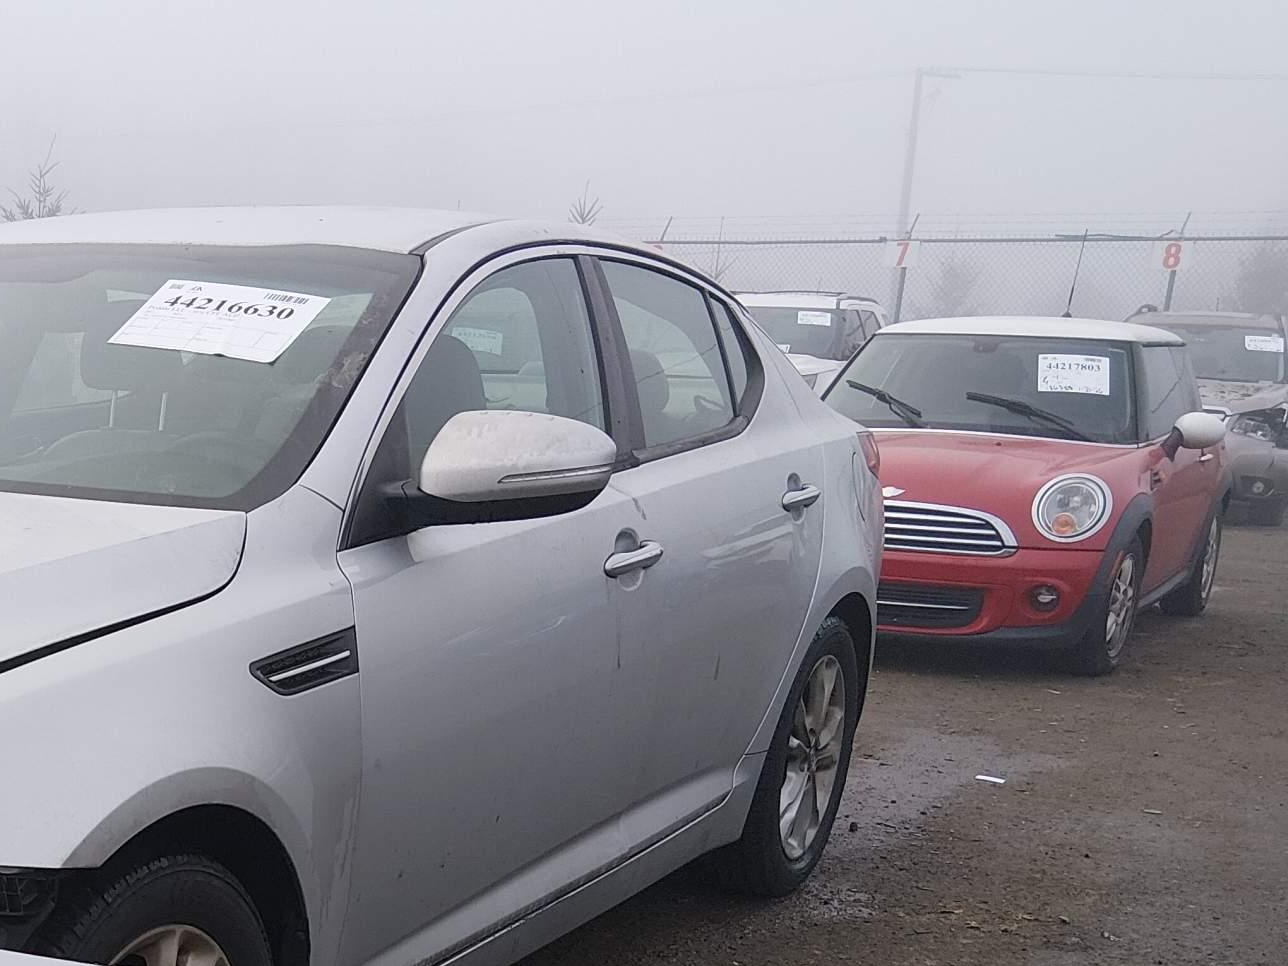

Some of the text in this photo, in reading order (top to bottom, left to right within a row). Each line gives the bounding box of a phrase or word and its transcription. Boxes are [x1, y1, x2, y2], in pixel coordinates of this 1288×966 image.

[895, 242, 910, 267] 7
[1163, 243, 1182, 269] 8
[163, 295, 295, 321] 44216630
[1046, 362, 1102, 372] 44217803
